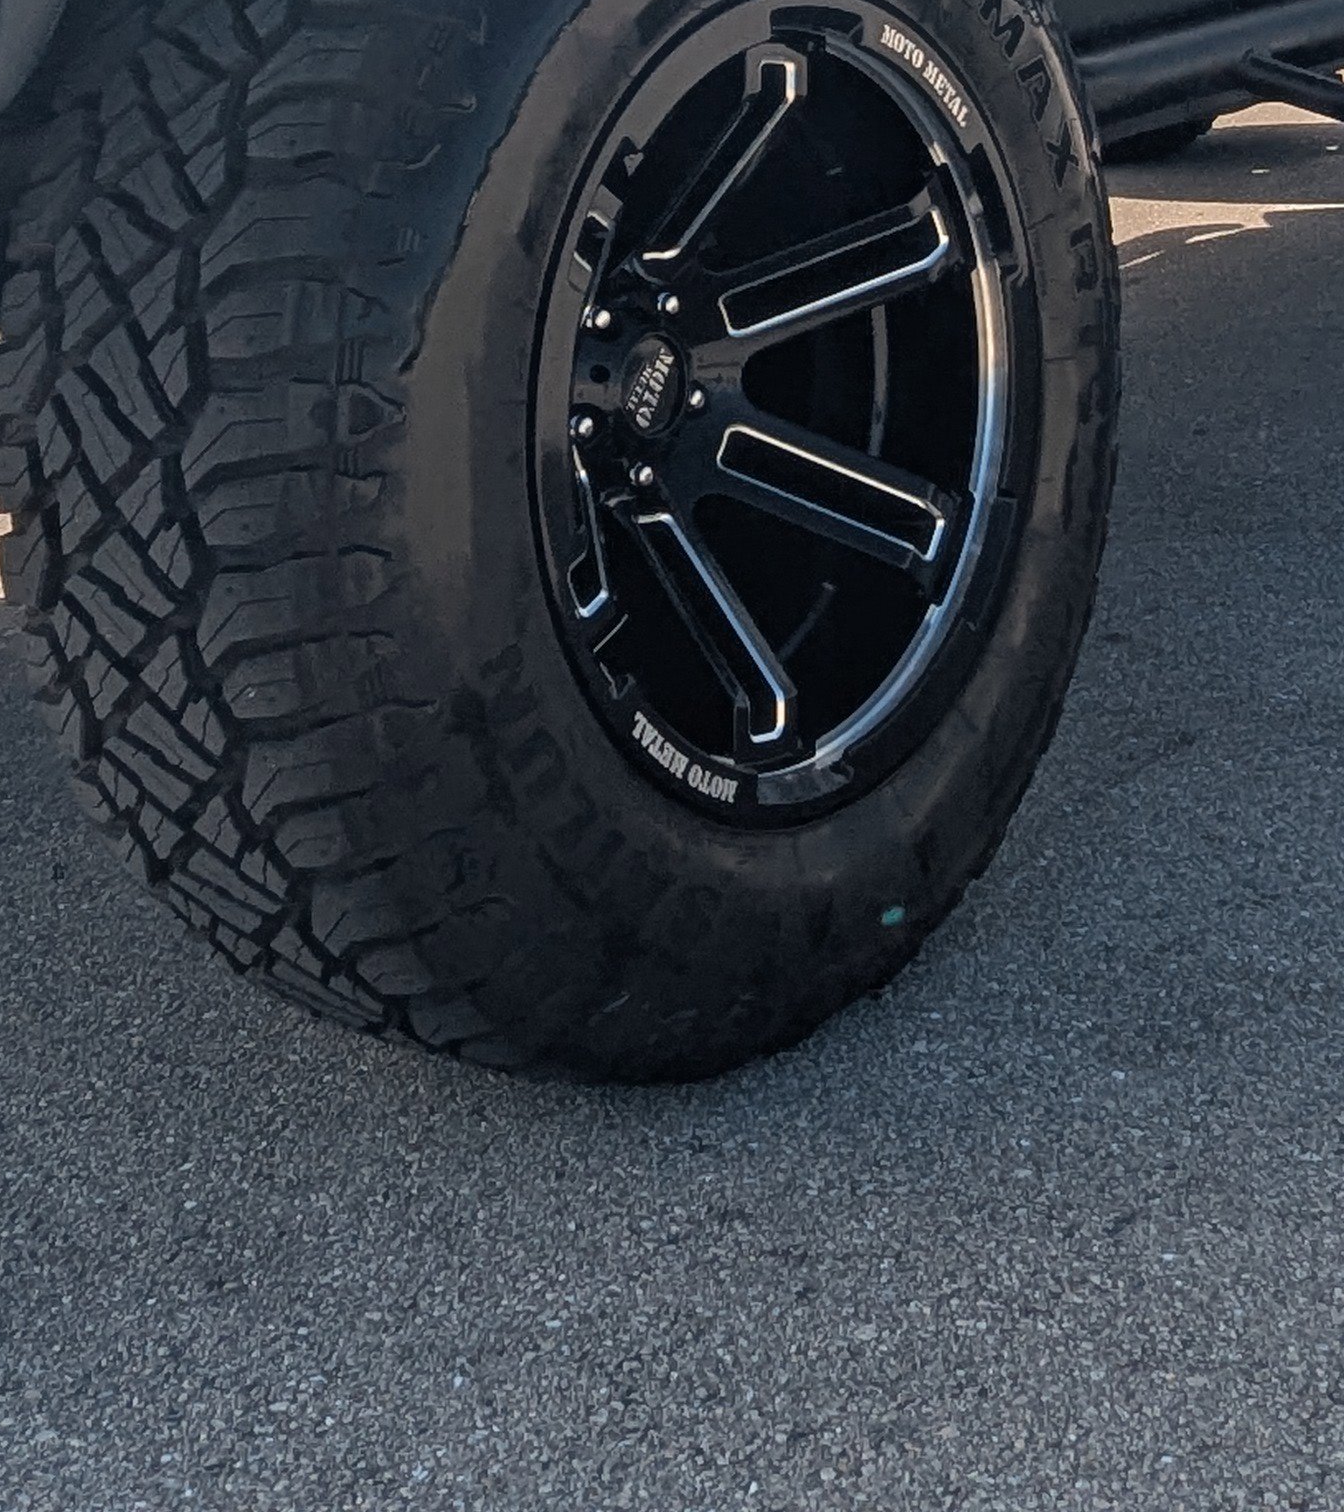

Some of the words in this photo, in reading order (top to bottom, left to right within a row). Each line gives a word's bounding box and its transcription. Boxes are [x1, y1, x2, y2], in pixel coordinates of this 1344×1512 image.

[880, 23, 924, 70] MOTO
[922, 59, 972, 128] METAL
[634, 346, 676, 429] MOTO
[631, 709, 690, 780] METAL
[686, 762, 740, 805] MOTO
